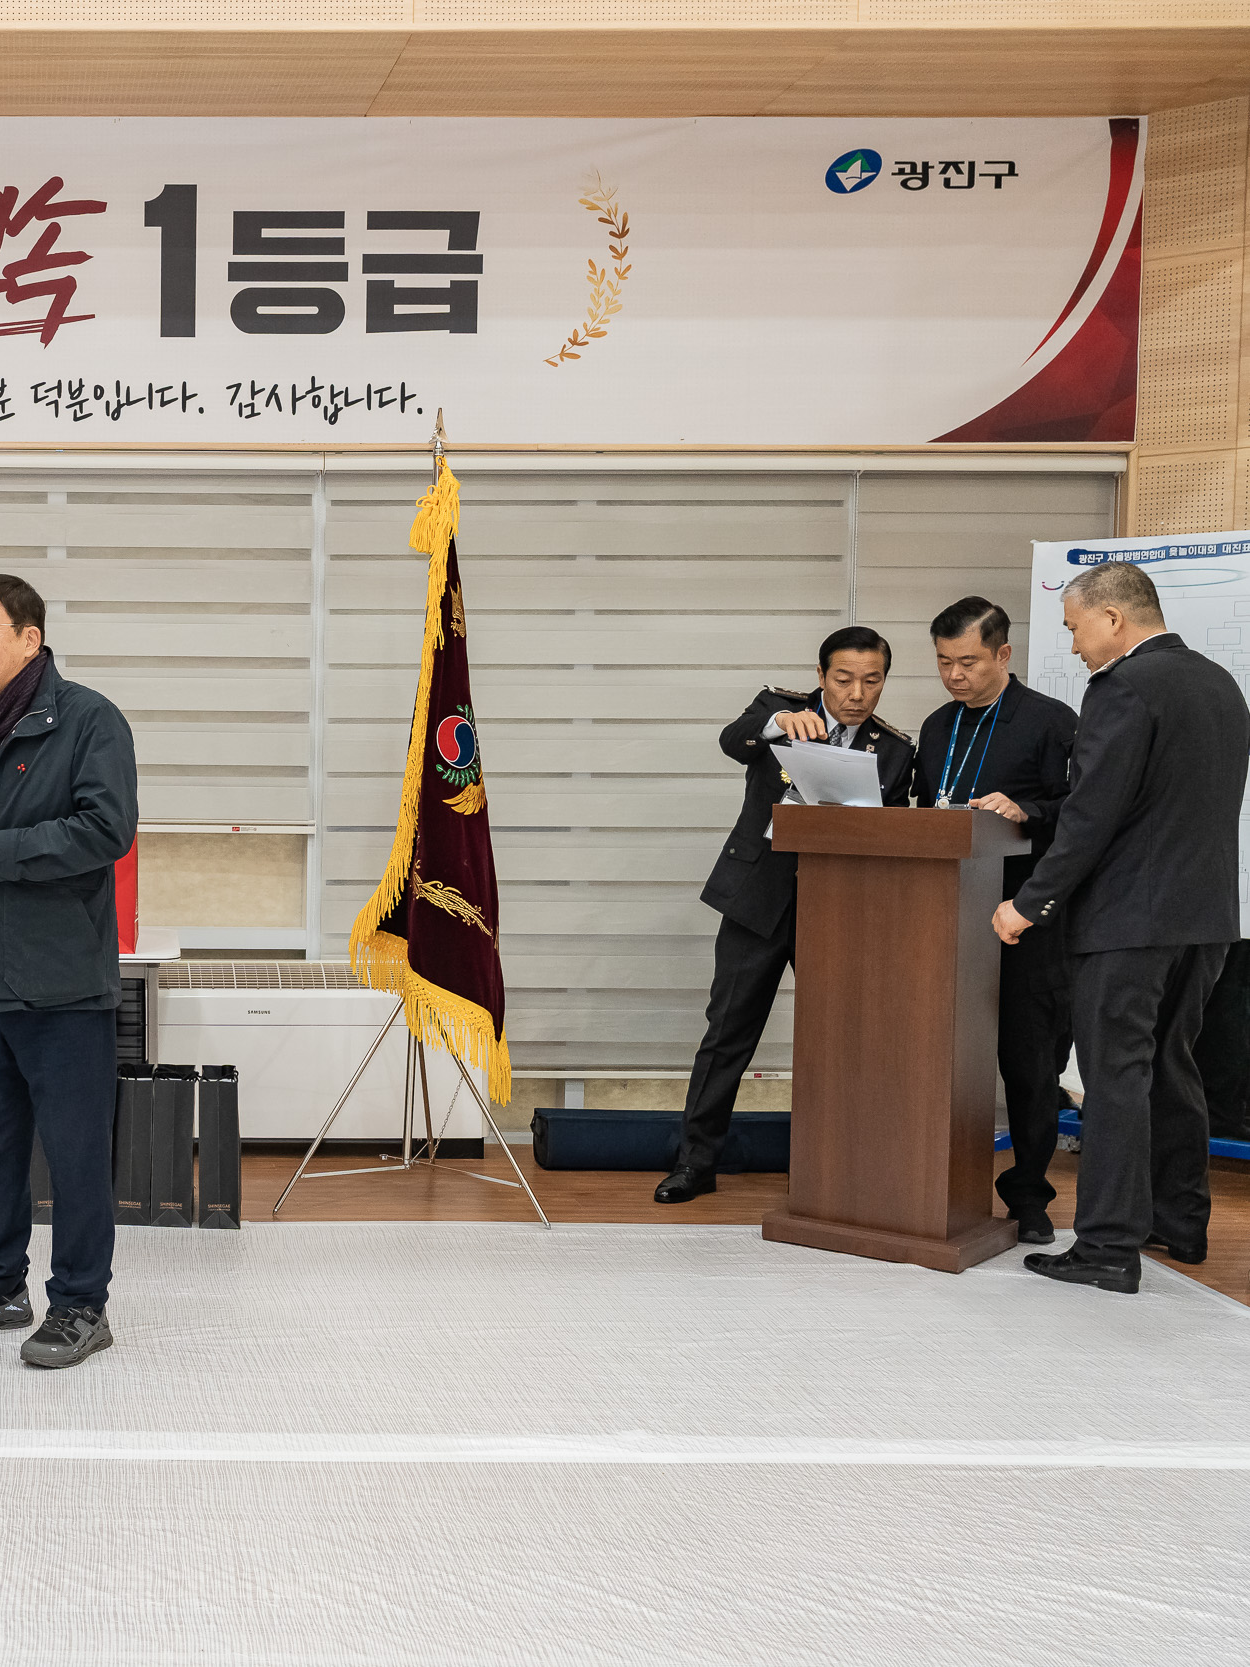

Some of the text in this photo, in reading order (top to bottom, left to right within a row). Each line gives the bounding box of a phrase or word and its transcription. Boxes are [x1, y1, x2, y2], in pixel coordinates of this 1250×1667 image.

[890, 160, 1020, 191] 광진구
[144, 183, 484, 338] 1등급
[30, 377, 205, 423] 덕분입니다.
[225, 376, 423, 425] 감사합니다.
[1078, 553, 1104, 564] 광진구
[1222, 542, 1250, 554] 대진표
